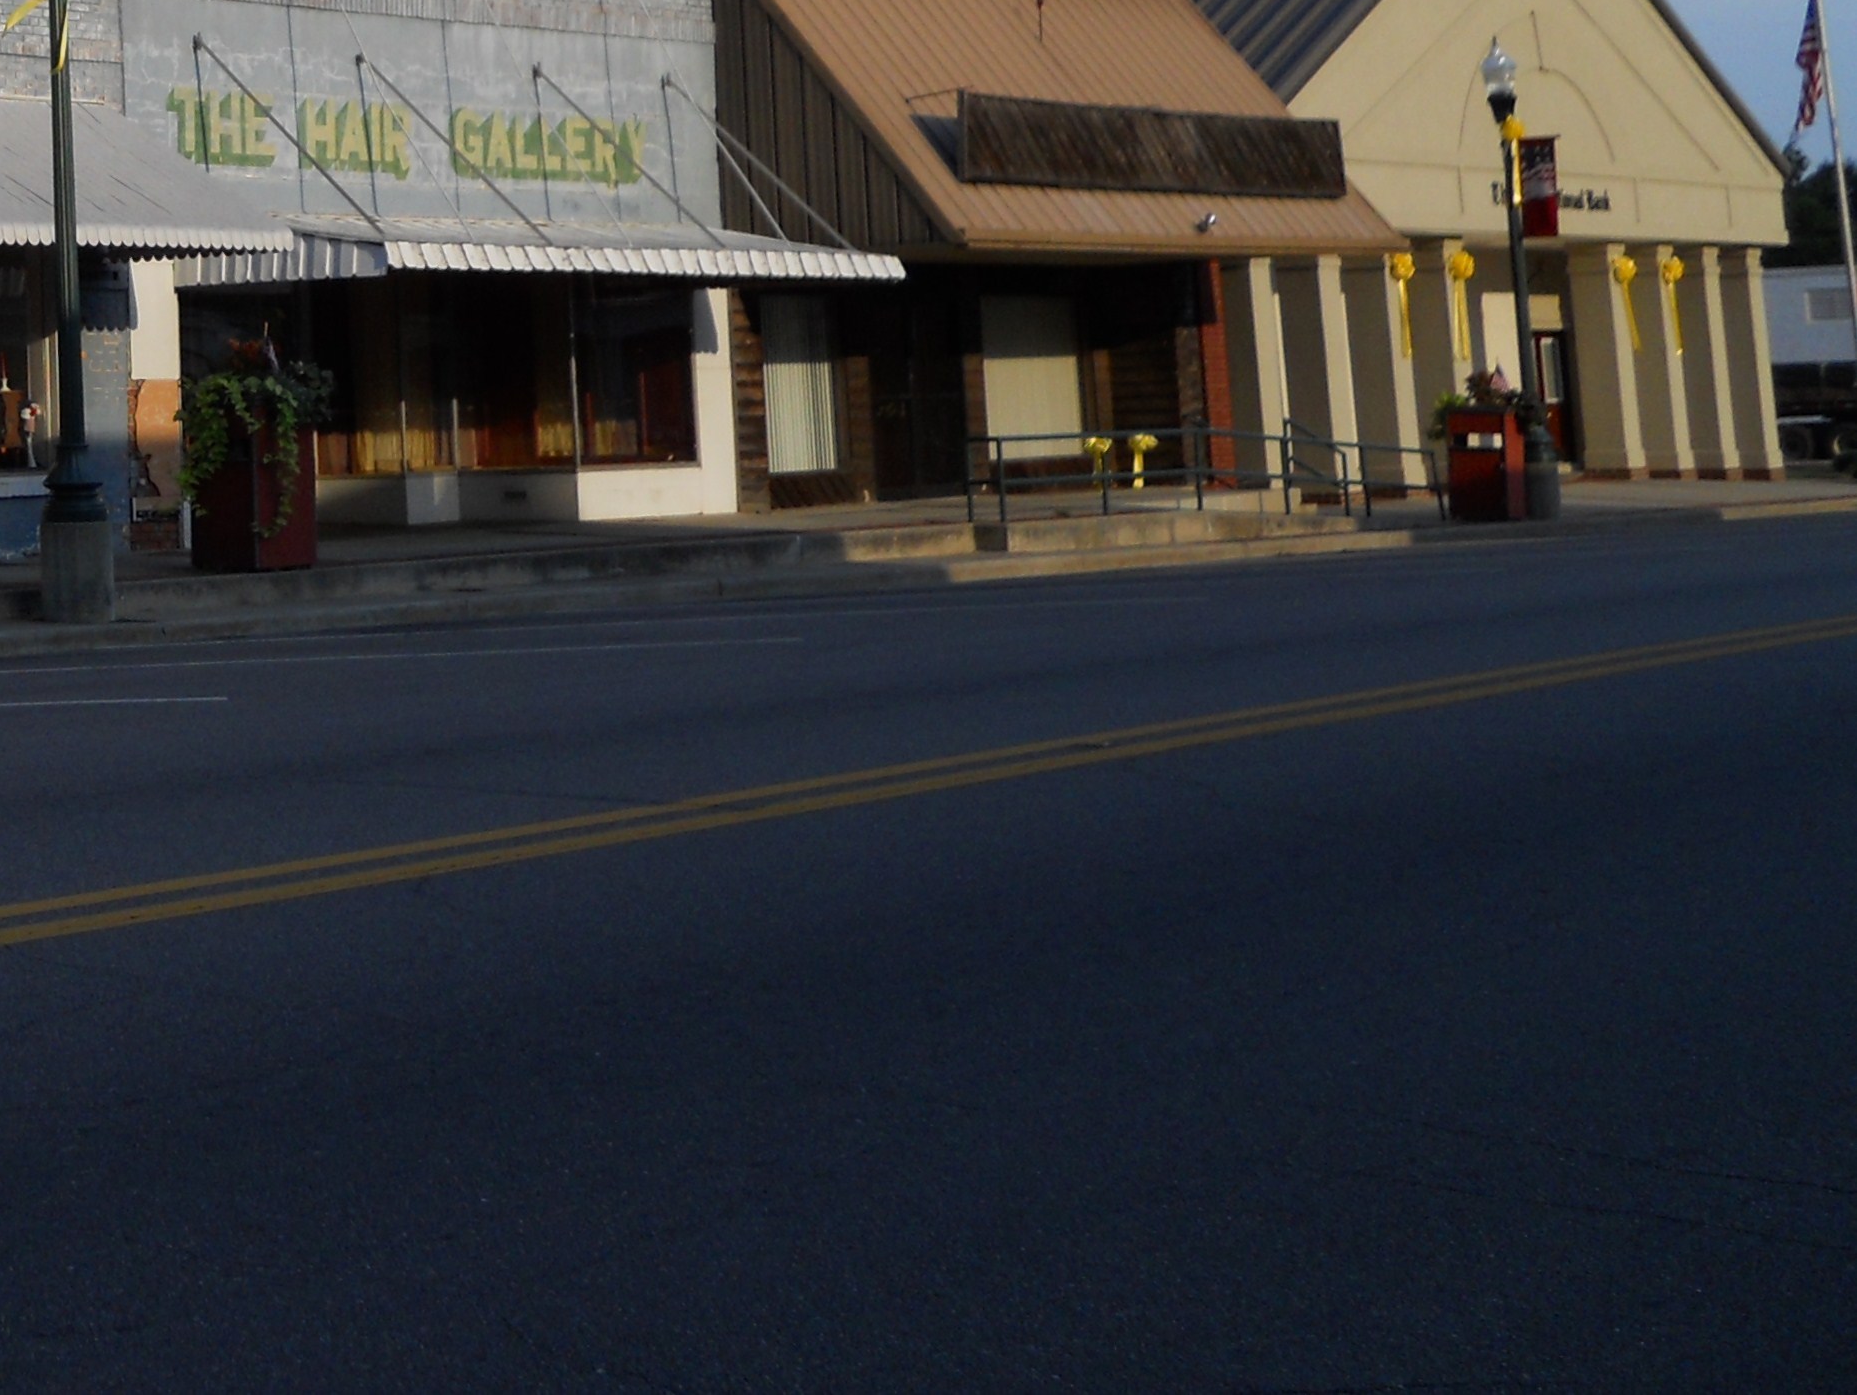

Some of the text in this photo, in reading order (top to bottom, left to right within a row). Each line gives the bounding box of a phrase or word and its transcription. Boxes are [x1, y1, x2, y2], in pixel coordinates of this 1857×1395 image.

[168, 87, 643, 185] THE HAIR GALLERY
